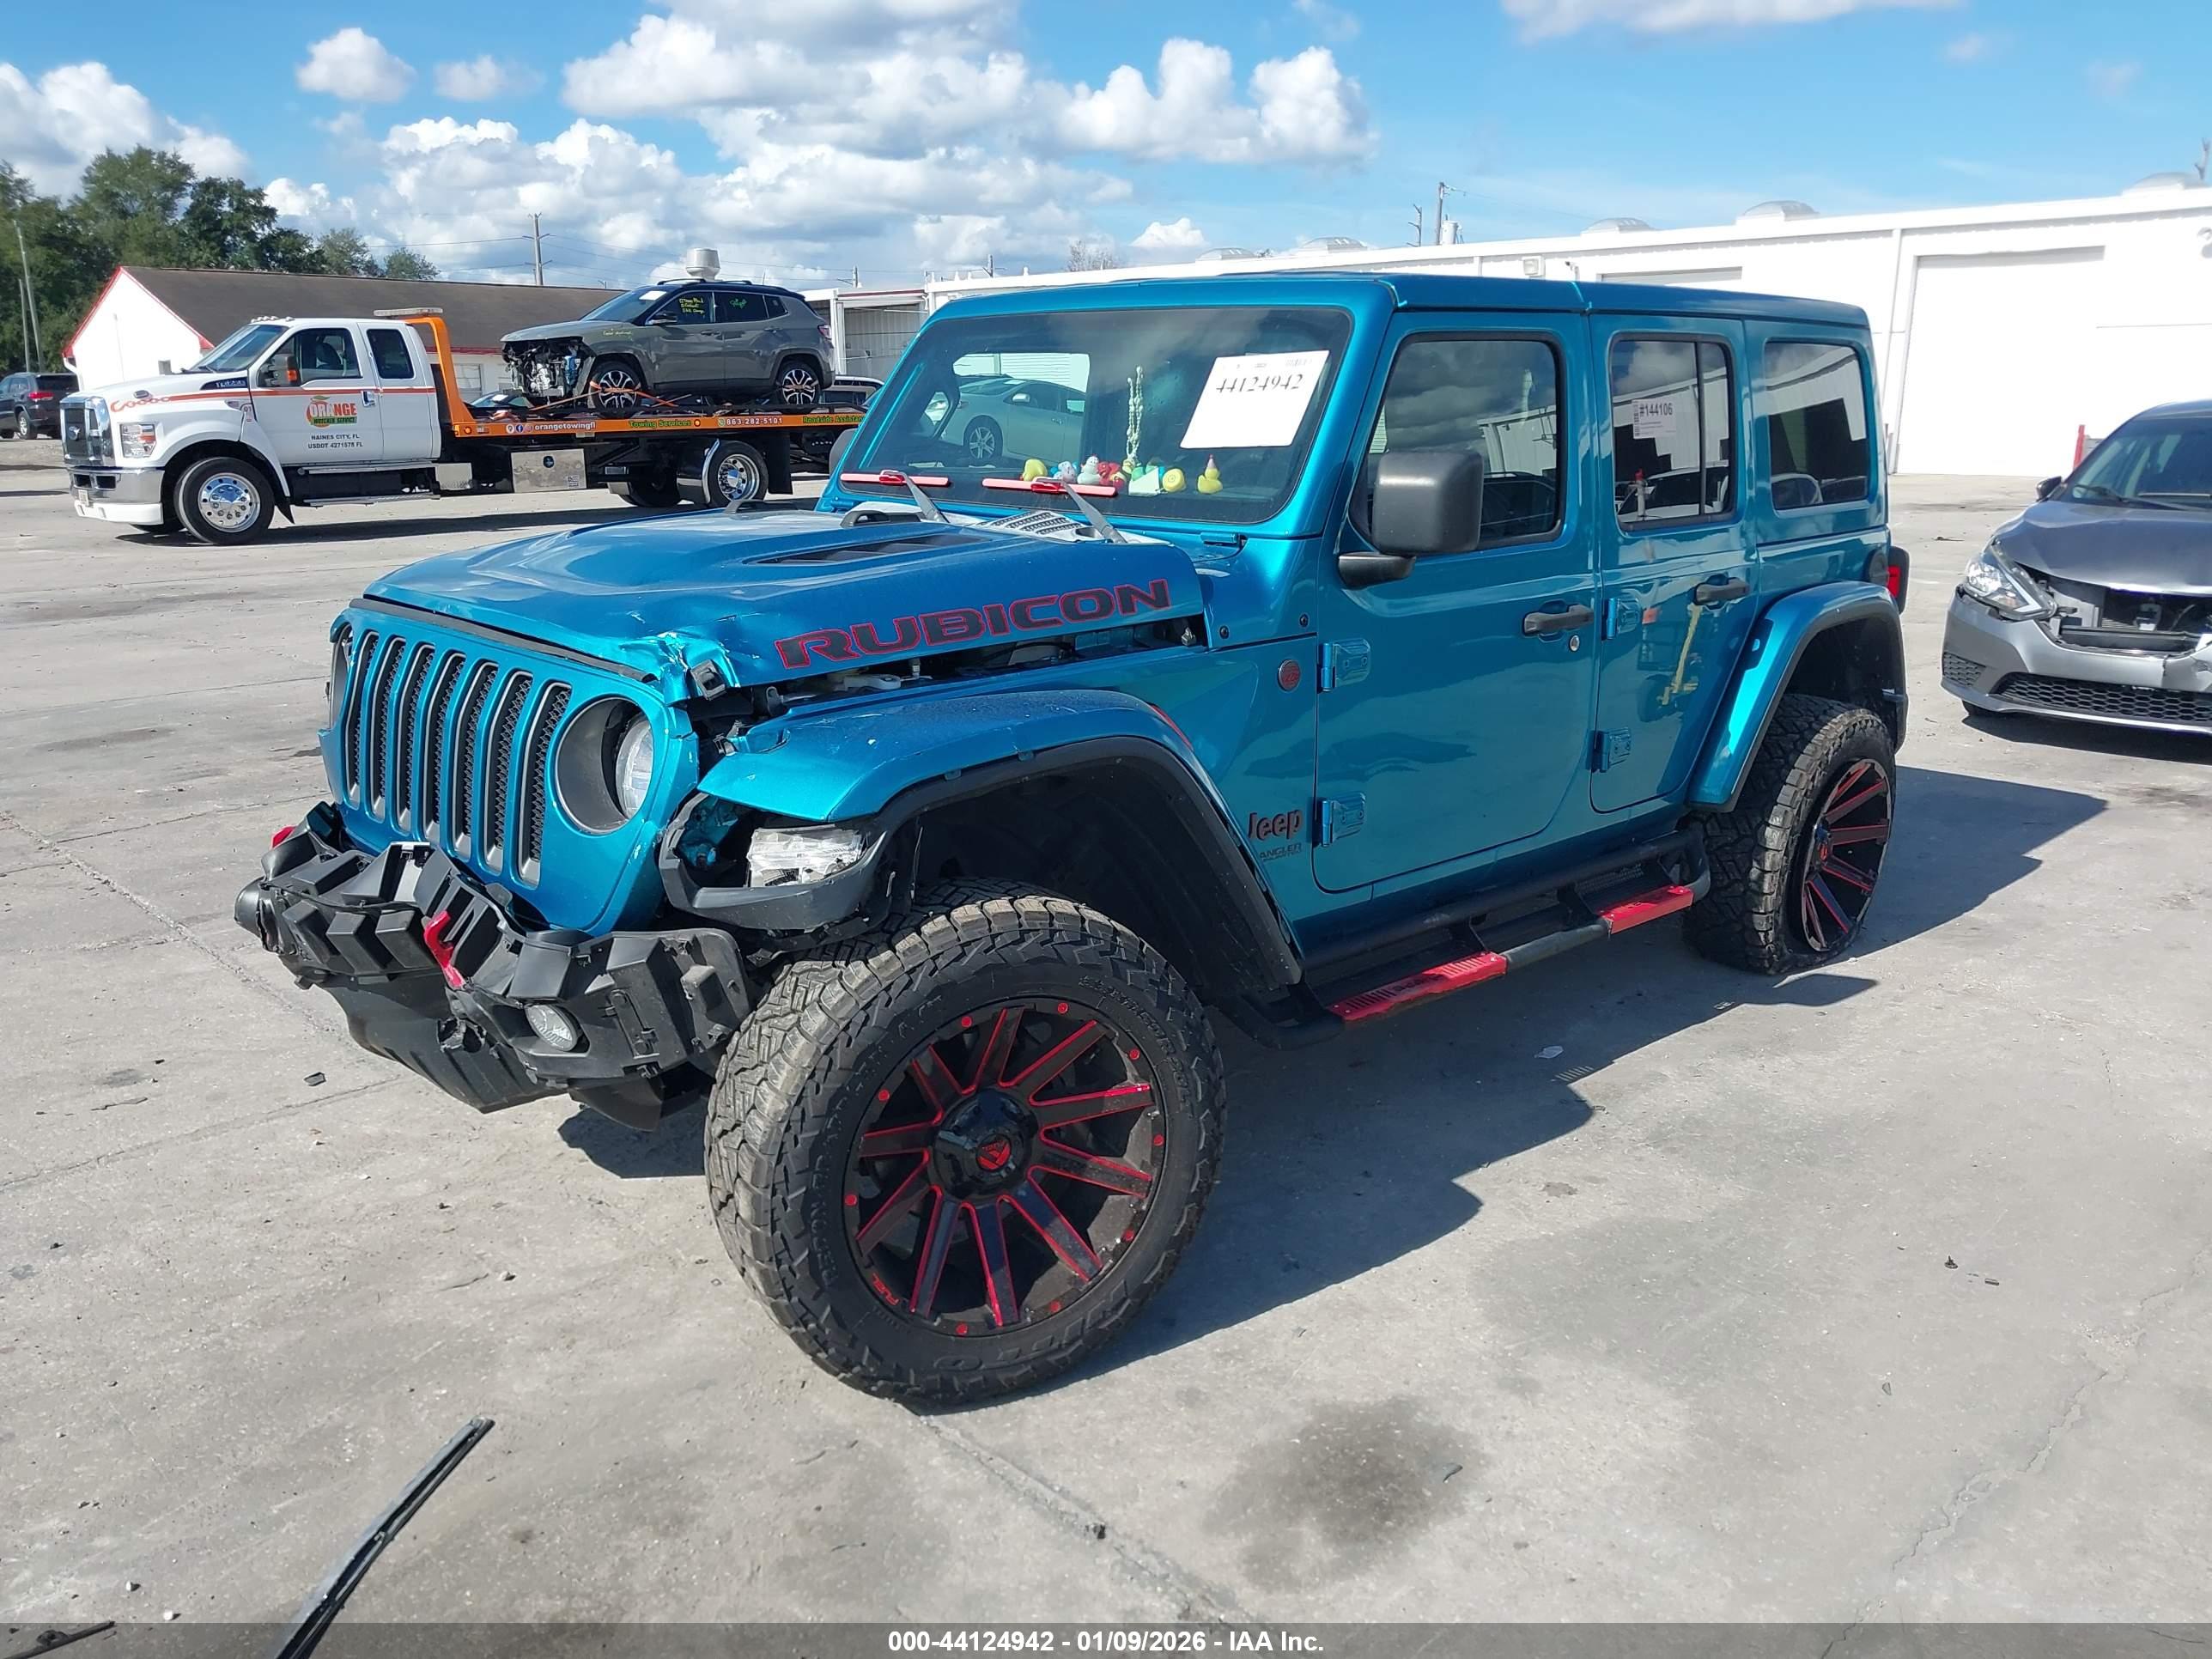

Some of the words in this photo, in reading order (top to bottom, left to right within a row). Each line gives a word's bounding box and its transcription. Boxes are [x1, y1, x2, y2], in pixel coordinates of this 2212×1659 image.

[1216, 374, 1304, 393] 44124942
[309, 404, 357, 417] ORANGE
[1639, 403, 1673, 416] #144106
[629, 420, 657, 428] Towing
[658, 418, 692, 428] Services
[726, 417, 783, 426] 863-282-5101
[775, 579, 1172, 670] RUBICON
[1248, 810, 1303, 841] Jeep
[872, 1272, 899, 1306] FUEL
